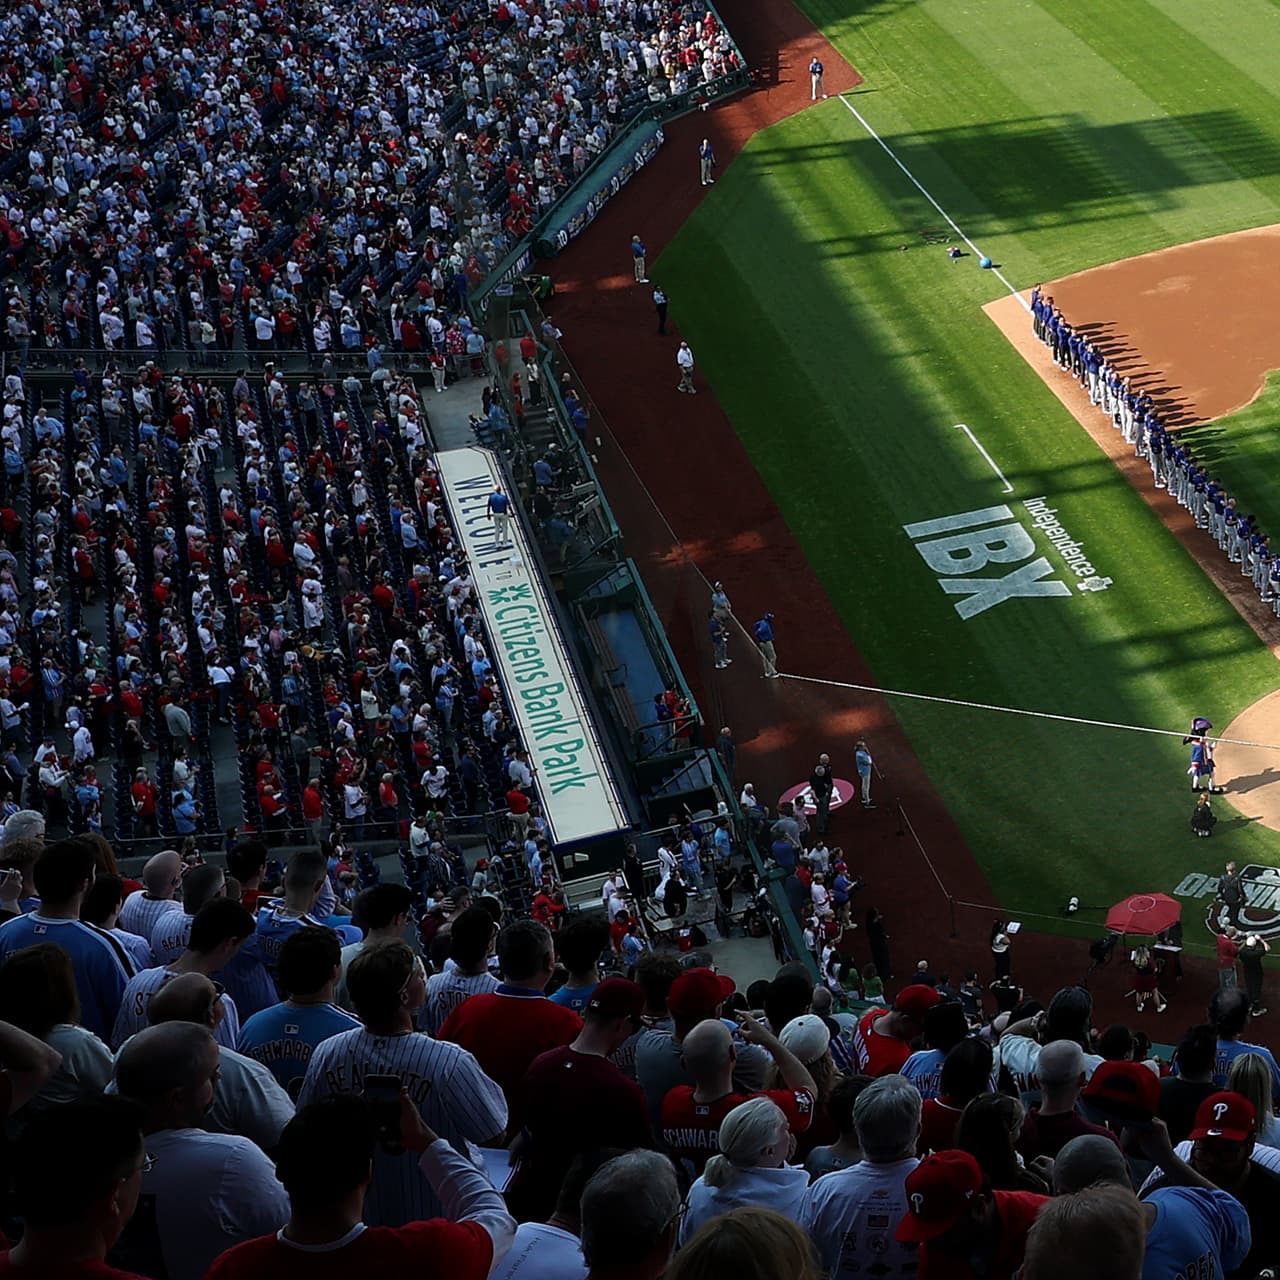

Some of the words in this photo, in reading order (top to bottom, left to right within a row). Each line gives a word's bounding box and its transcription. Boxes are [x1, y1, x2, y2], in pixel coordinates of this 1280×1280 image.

[453, 475, 515, 570] WELCOME
[1023, 496, 1096, 576] Independence
[902, 504, 1072, 620] IBX
[495, 604, 546, 685] Citizens
[520, 682, 564, 738] Bank
[533, 738, 586, 794] Park
[1213, 1102, 1229, 1121] P
[910, 1192, 924, 1214] P
